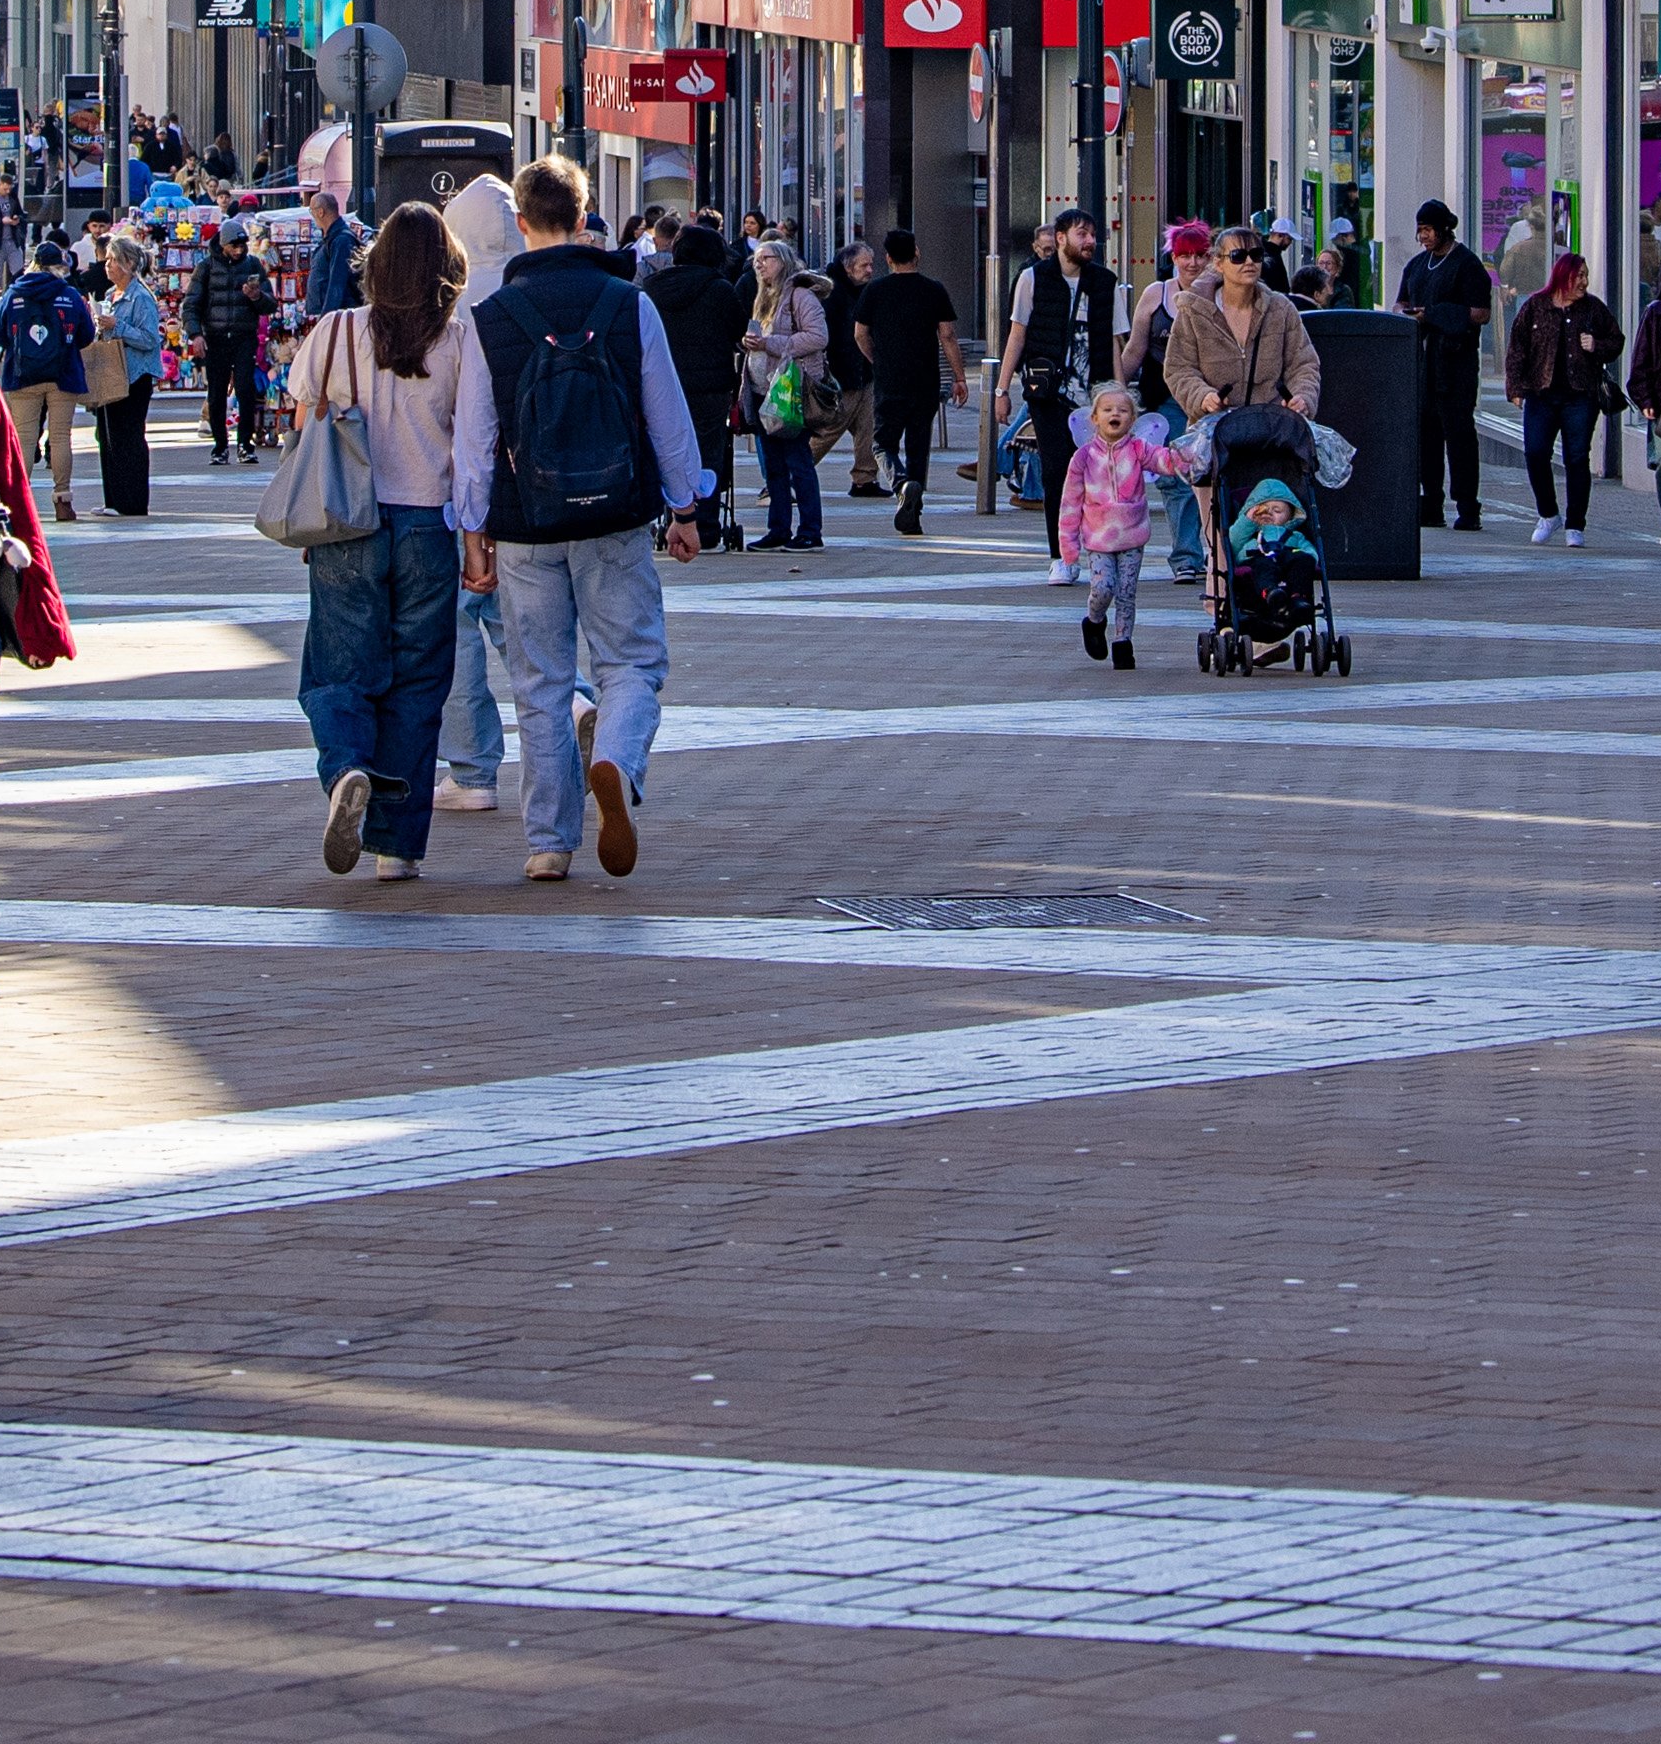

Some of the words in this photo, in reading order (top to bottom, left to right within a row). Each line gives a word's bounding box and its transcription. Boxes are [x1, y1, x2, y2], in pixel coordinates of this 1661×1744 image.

[198, 18, 215, 26] new
[217, 18, 253, 26] balance
[1186, 26, 1205, 35] THE
[1180, 35, 1213, 45] BODY
[1180, 45, 1212, 55] SHOP
[422, 138, 474, 147] TELEPHONE
